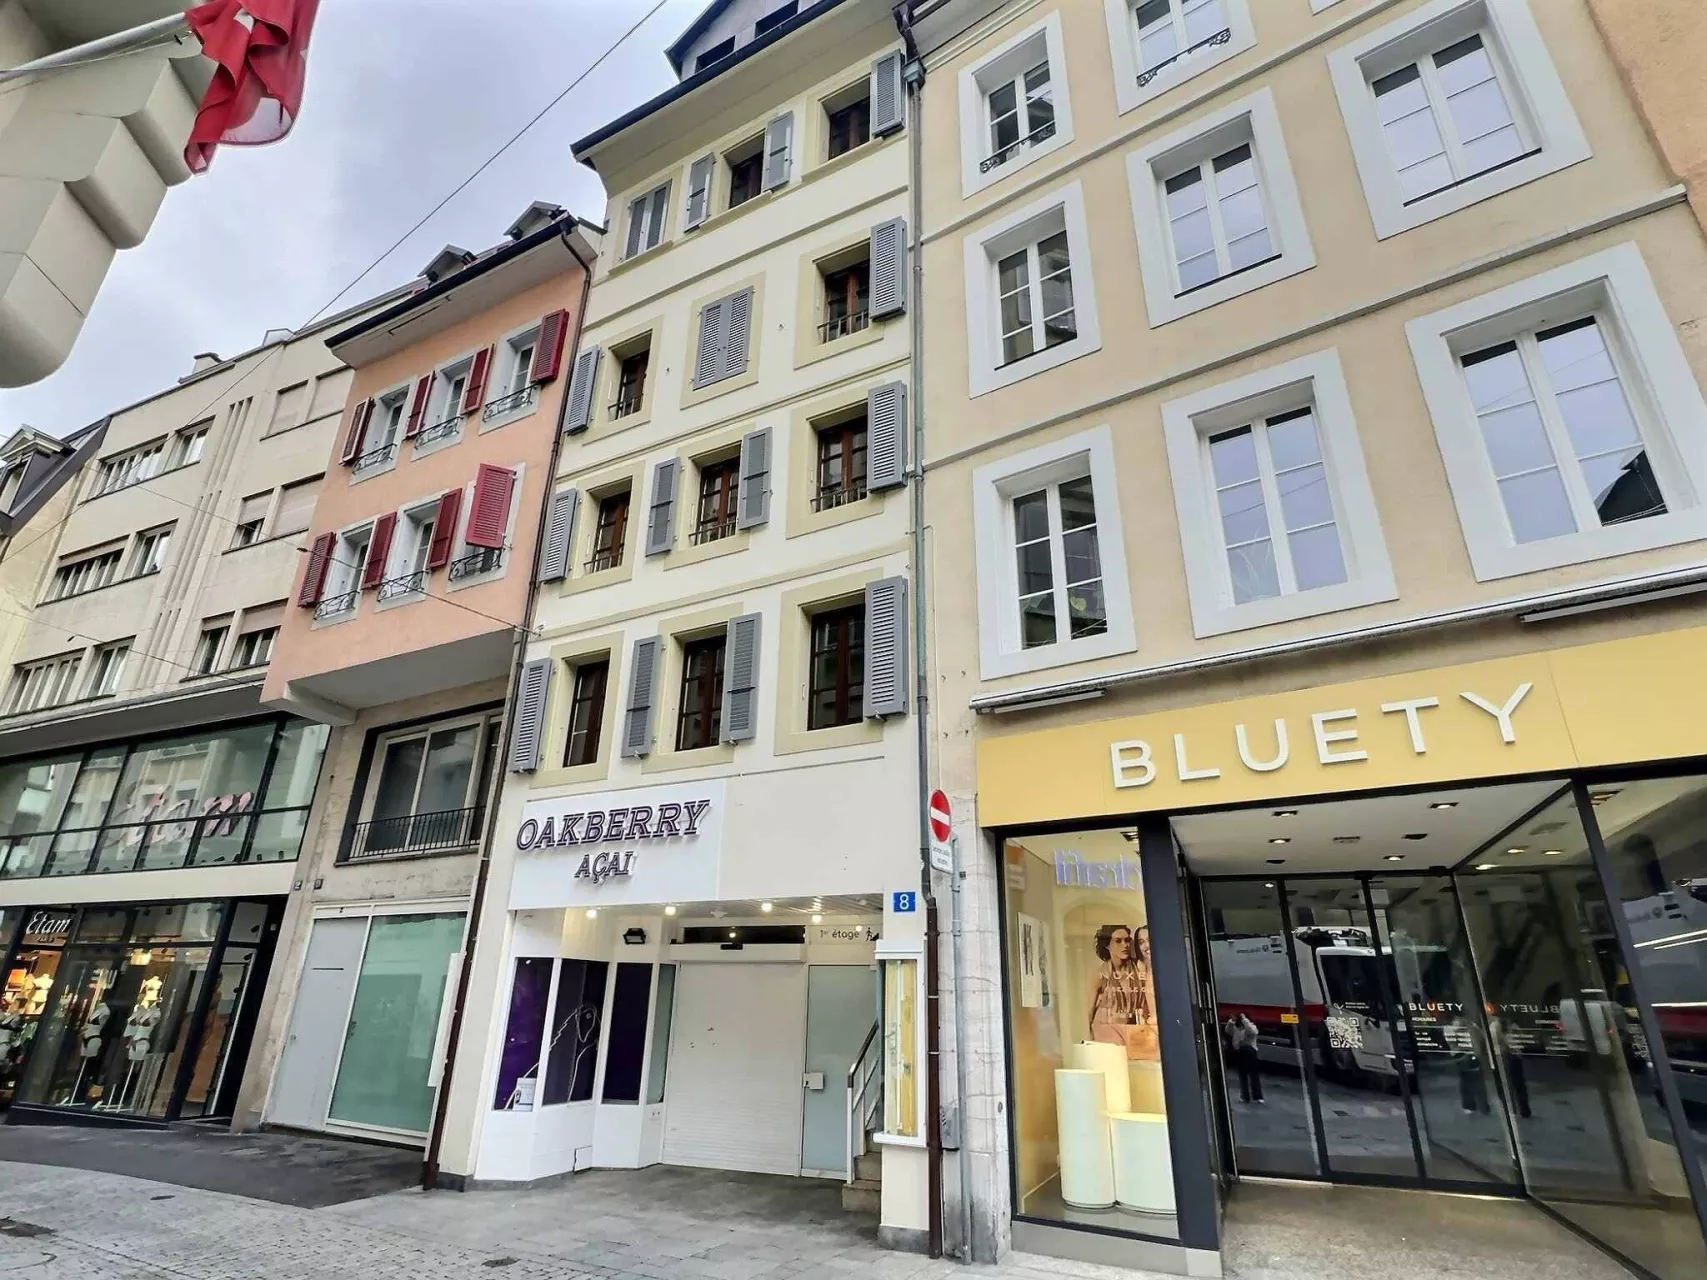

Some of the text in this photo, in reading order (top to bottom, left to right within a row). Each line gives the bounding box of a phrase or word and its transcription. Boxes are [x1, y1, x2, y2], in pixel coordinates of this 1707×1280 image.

[1110, 682, 1534, 789] BLUETY
[516, 799, 711, 851] OAKBERRY
[574, 851, 634, 884] AÇAI
[900, 893, 909, 910] 8
[26, 911, 72, 934] Etam
[1408, 1002, 1463, 1012] BLUETY
